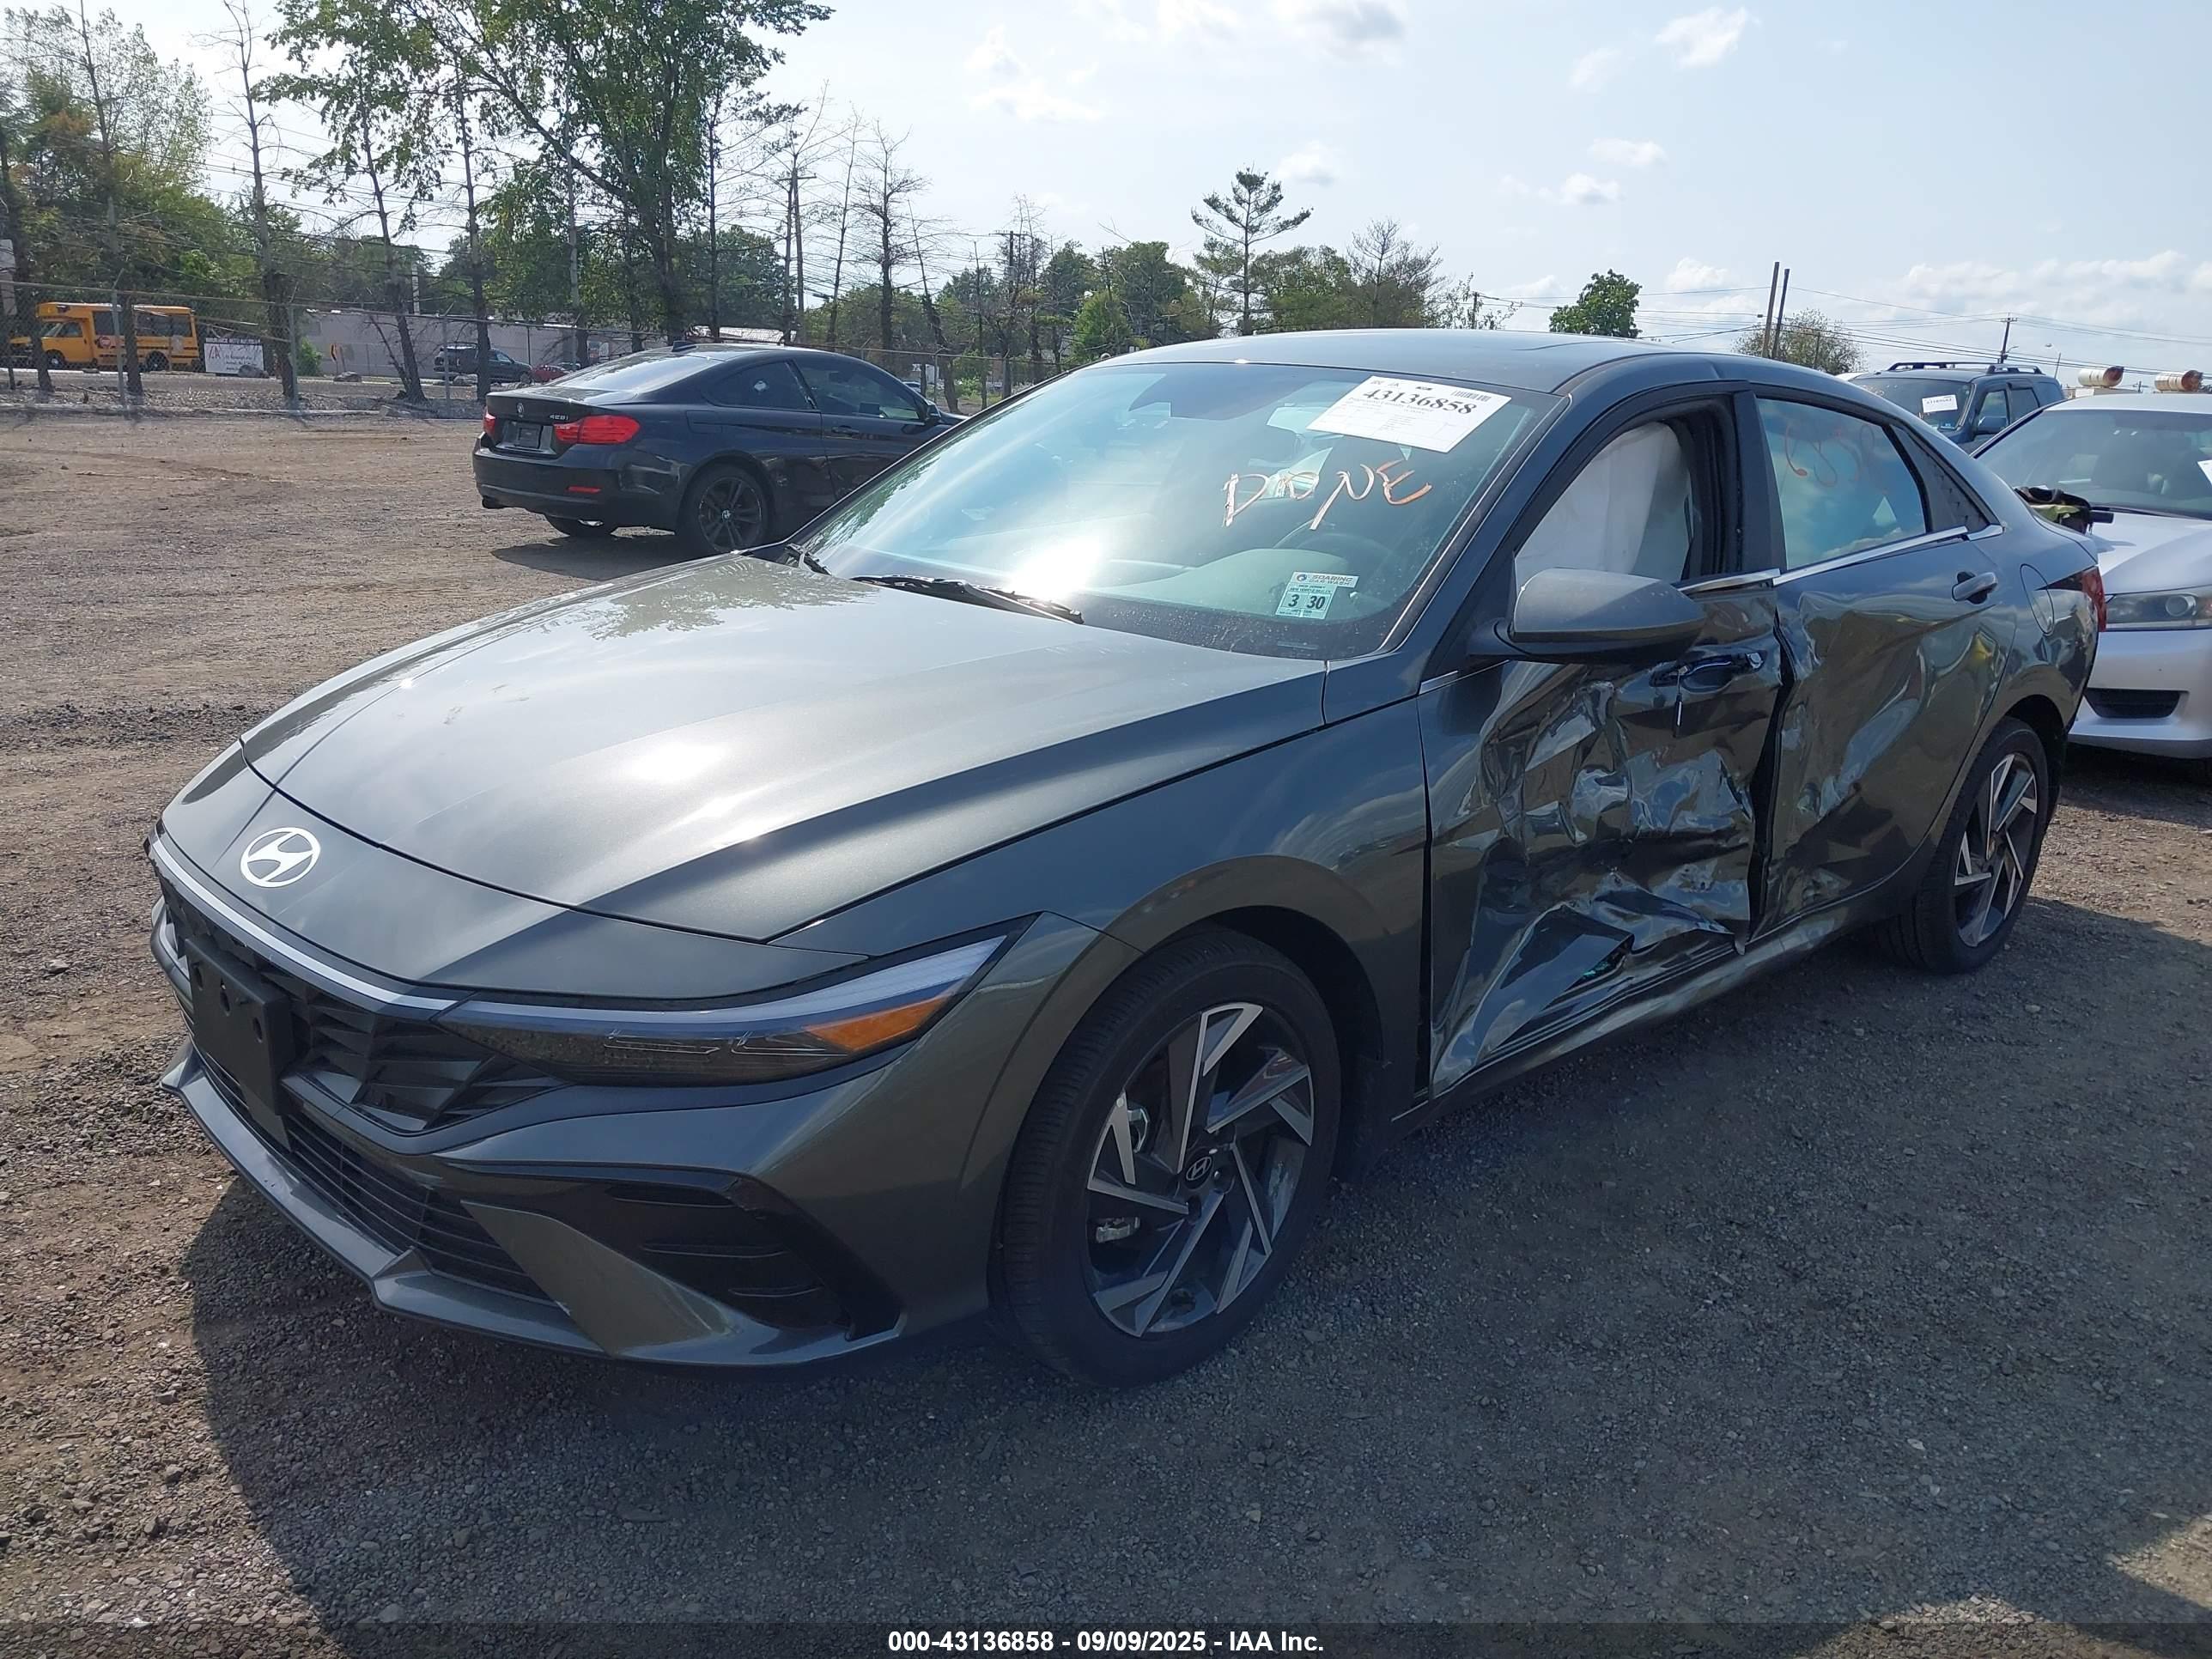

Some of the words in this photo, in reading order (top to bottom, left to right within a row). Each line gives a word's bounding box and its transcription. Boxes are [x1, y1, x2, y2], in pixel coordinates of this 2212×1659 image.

[1363, 388, 1477, 415] 43136858
[1222, 459, 1432, 532] DONE
[1288, 593, 1300, 607] 3
[1306, 595, 1326, 610] 30
